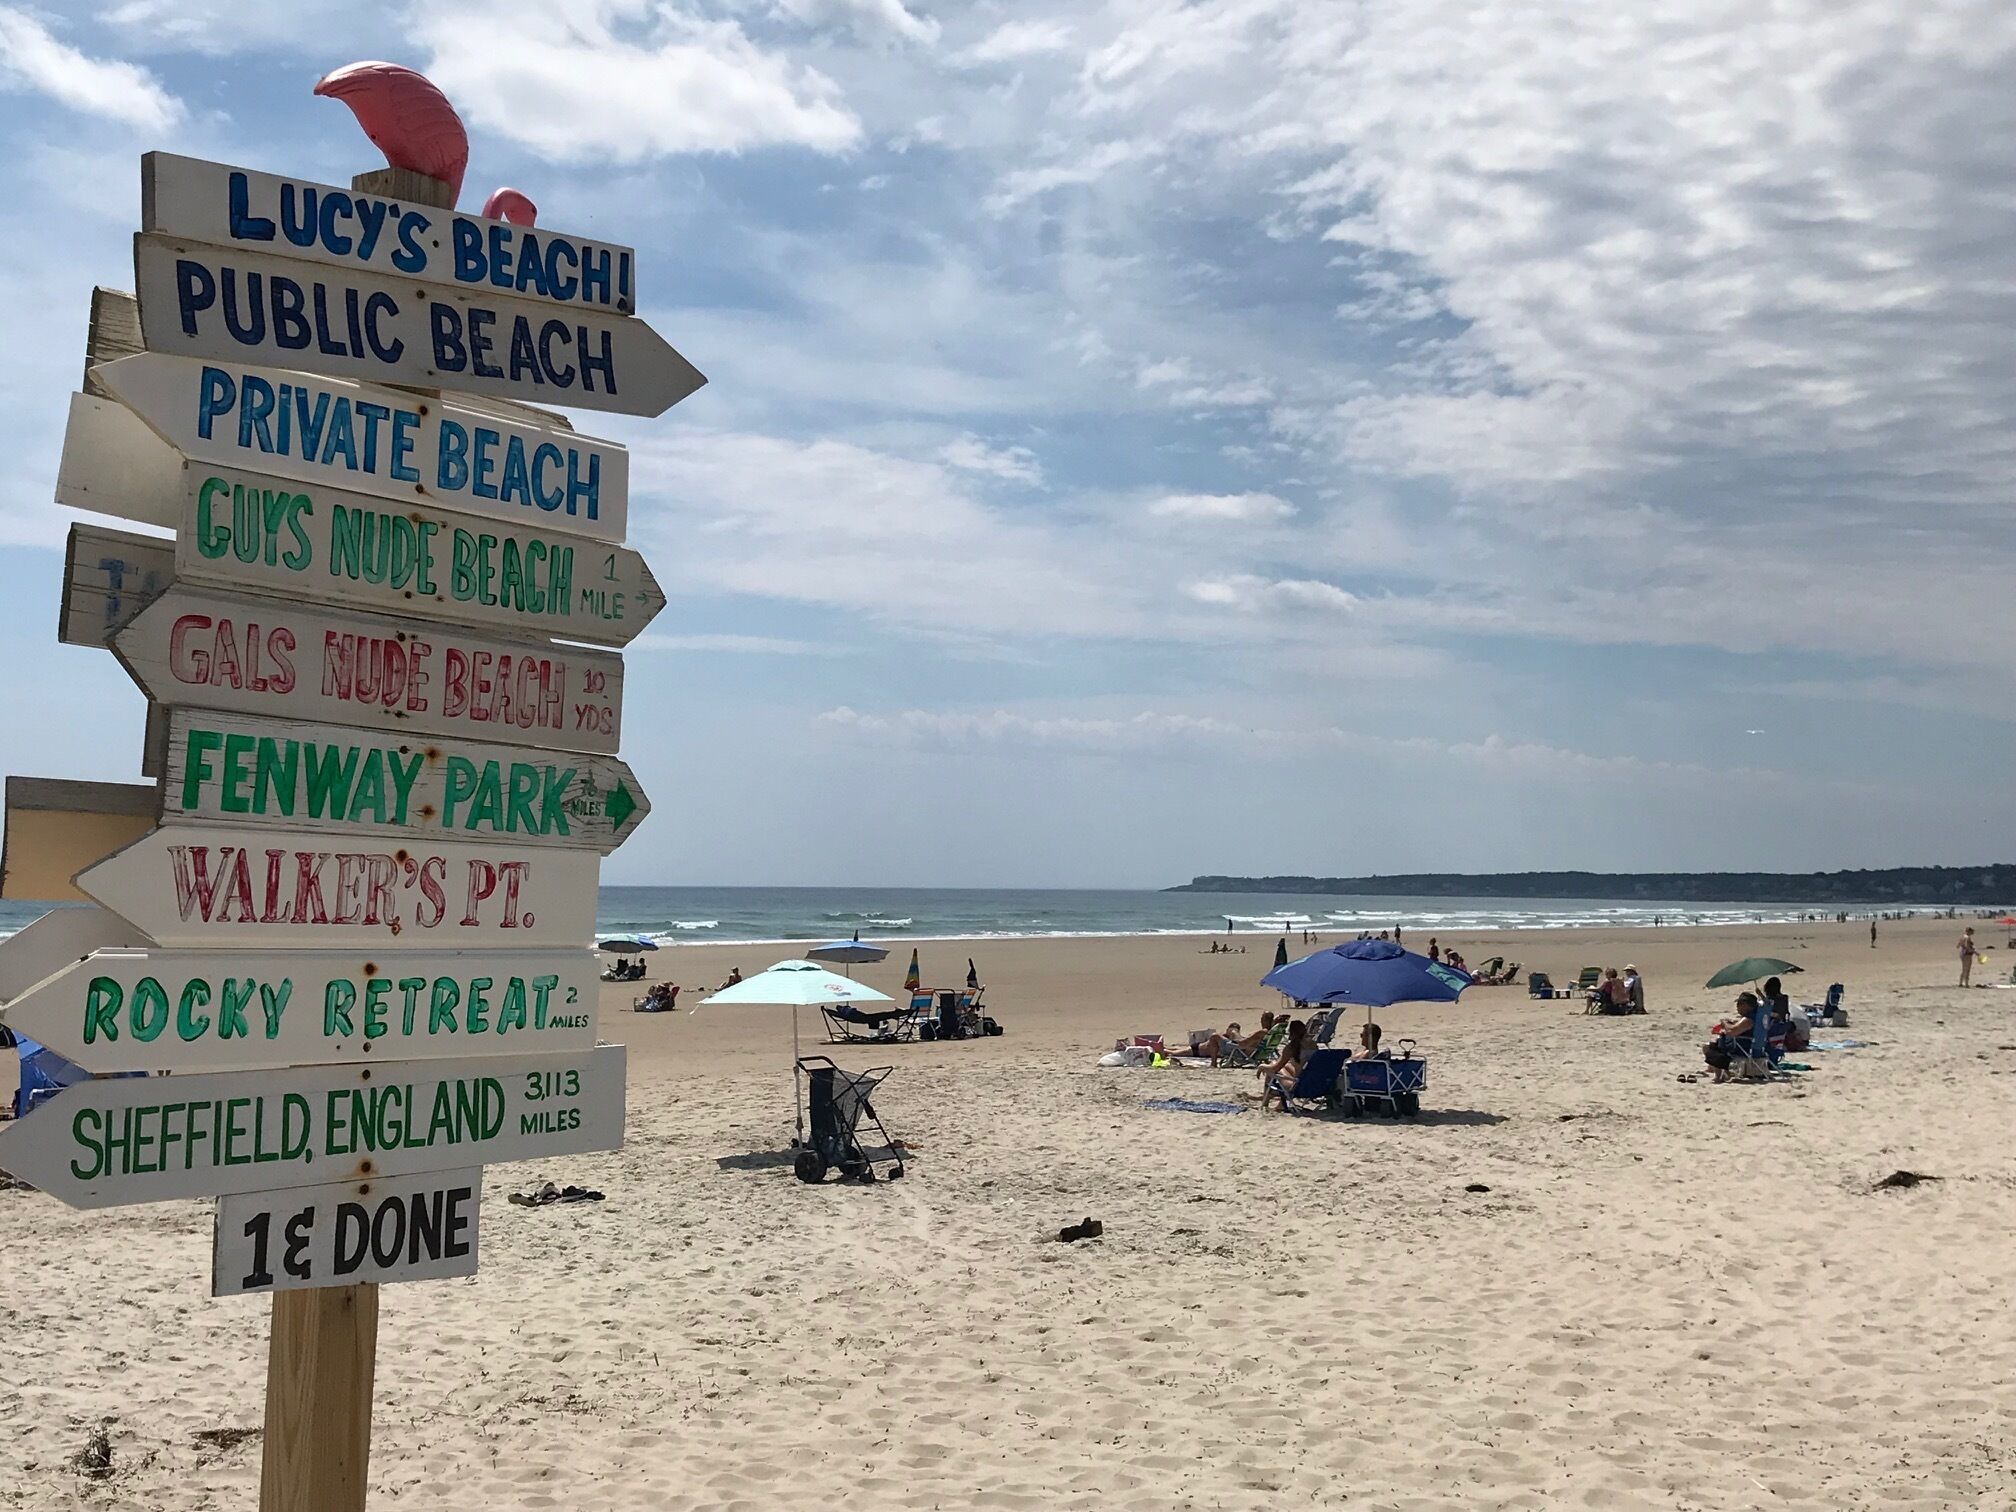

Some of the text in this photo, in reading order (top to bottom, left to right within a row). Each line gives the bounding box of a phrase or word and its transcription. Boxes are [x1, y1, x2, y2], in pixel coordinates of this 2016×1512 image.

[228, 172, 629, 310] LUCY'S BEACH!
[176, 260, 618, 395] PUBLIC BEACH
[198, 366, 599, 520] PRIVATE BEACH
[196, 477, 574, 616] GUYS NUDE BEACH
[603, 553, 620, 581] 1
[580, 588, 625, 619] MILE
[169, 615, 565, 730] GALS NUDE BEACH
[181, 729, 578, 836] FENWAY PARK
[167, 846, 535, 929] WALKER'S PT.
[83, 974, 559, 1044] ROCKY RETREAT
[550, 1015, 589, 1028] MILES
[566, 987, 578, 1003] 2
[71, 1077, 506, 1180] SHEFFIELD, ENGLAND
[520, 1108, 580, 1135] MILES
[524, 1069, 580, 1101] 3,113
[242, 1213, 274, 1288] 1
[334, 1187, 471, 1275] DONE
